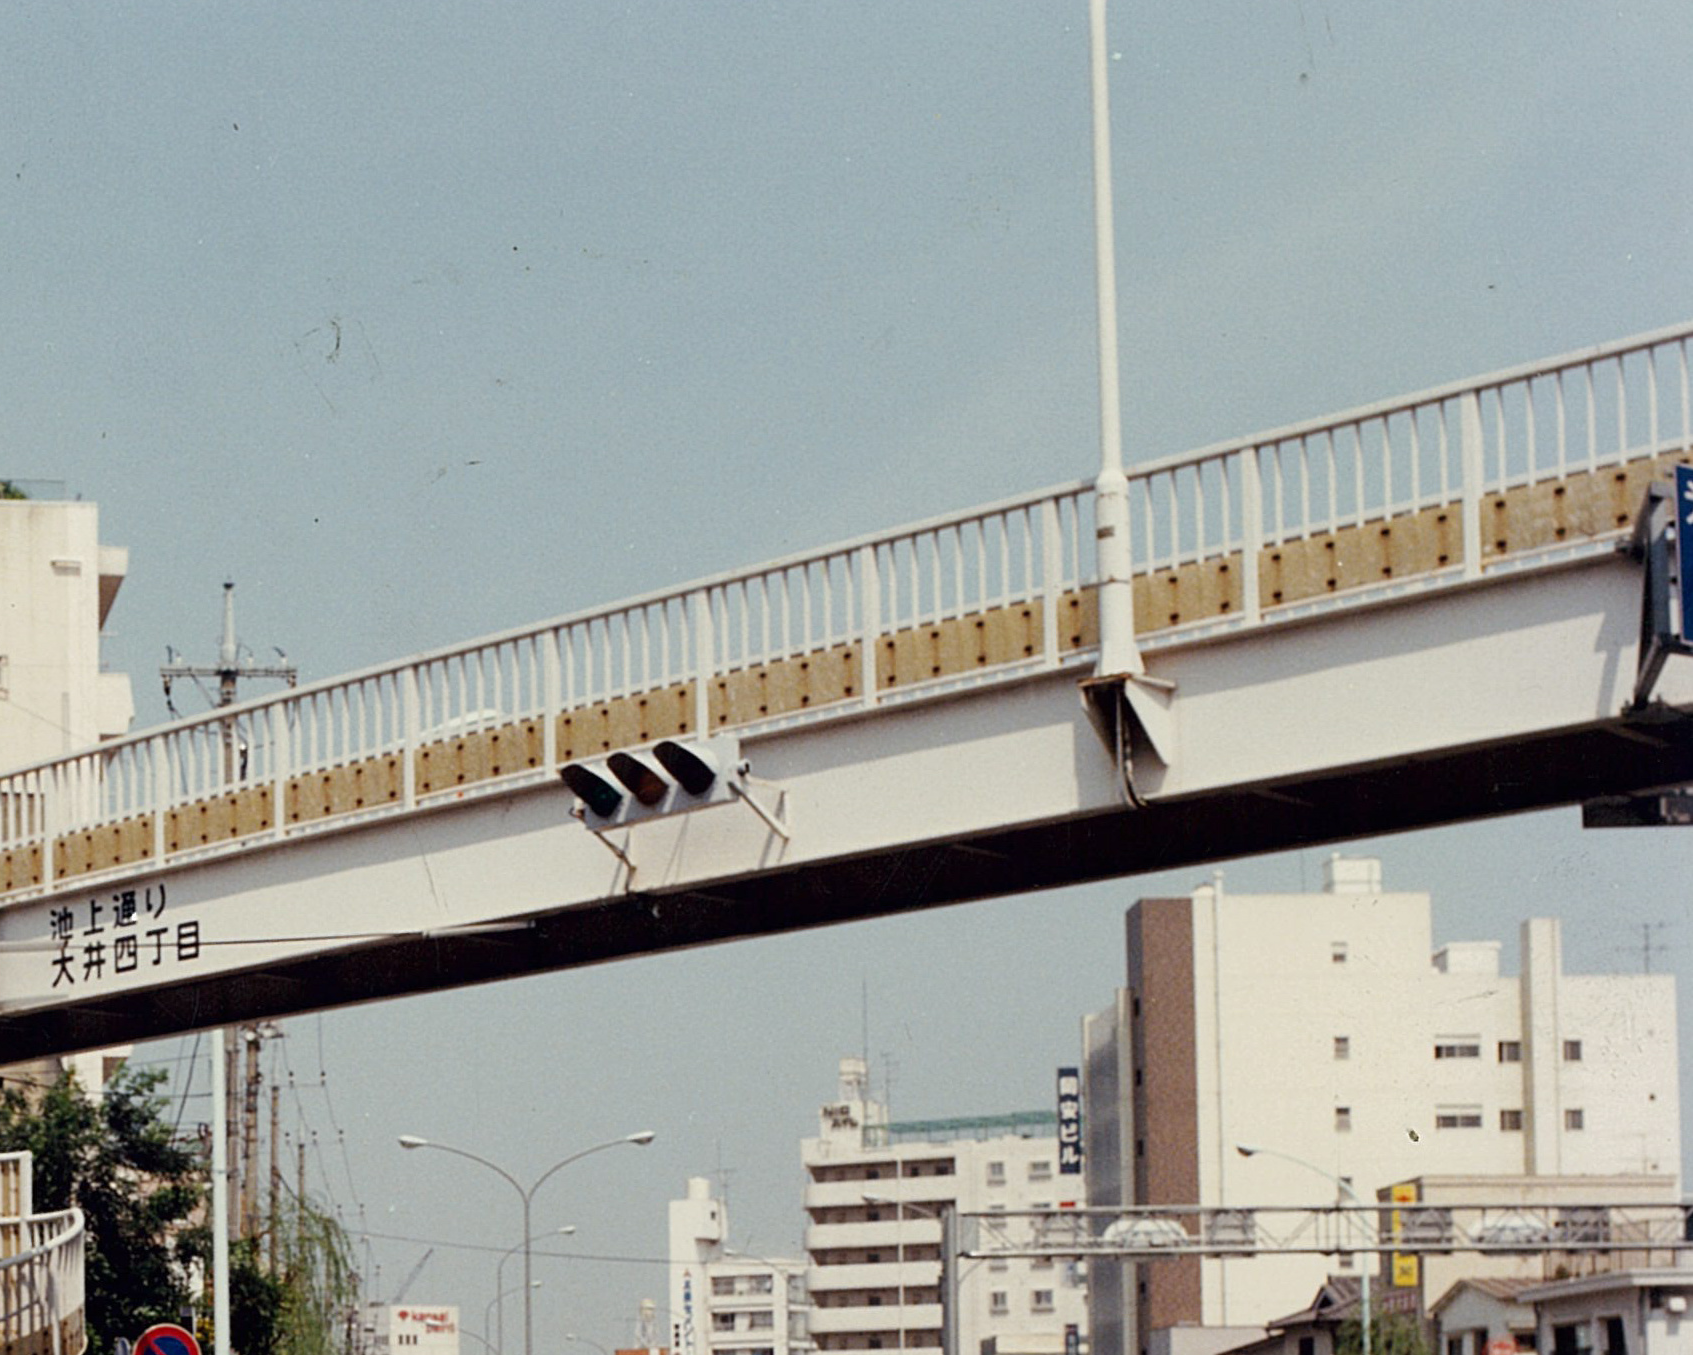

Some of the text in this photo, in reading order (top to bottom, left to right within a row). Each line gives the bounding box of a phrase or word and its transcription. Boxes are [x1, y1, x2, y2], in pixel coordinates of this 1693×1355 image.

[50, 884, 167, 942] 池上通り
[51, 920, 200, 988] 大井四丁目
